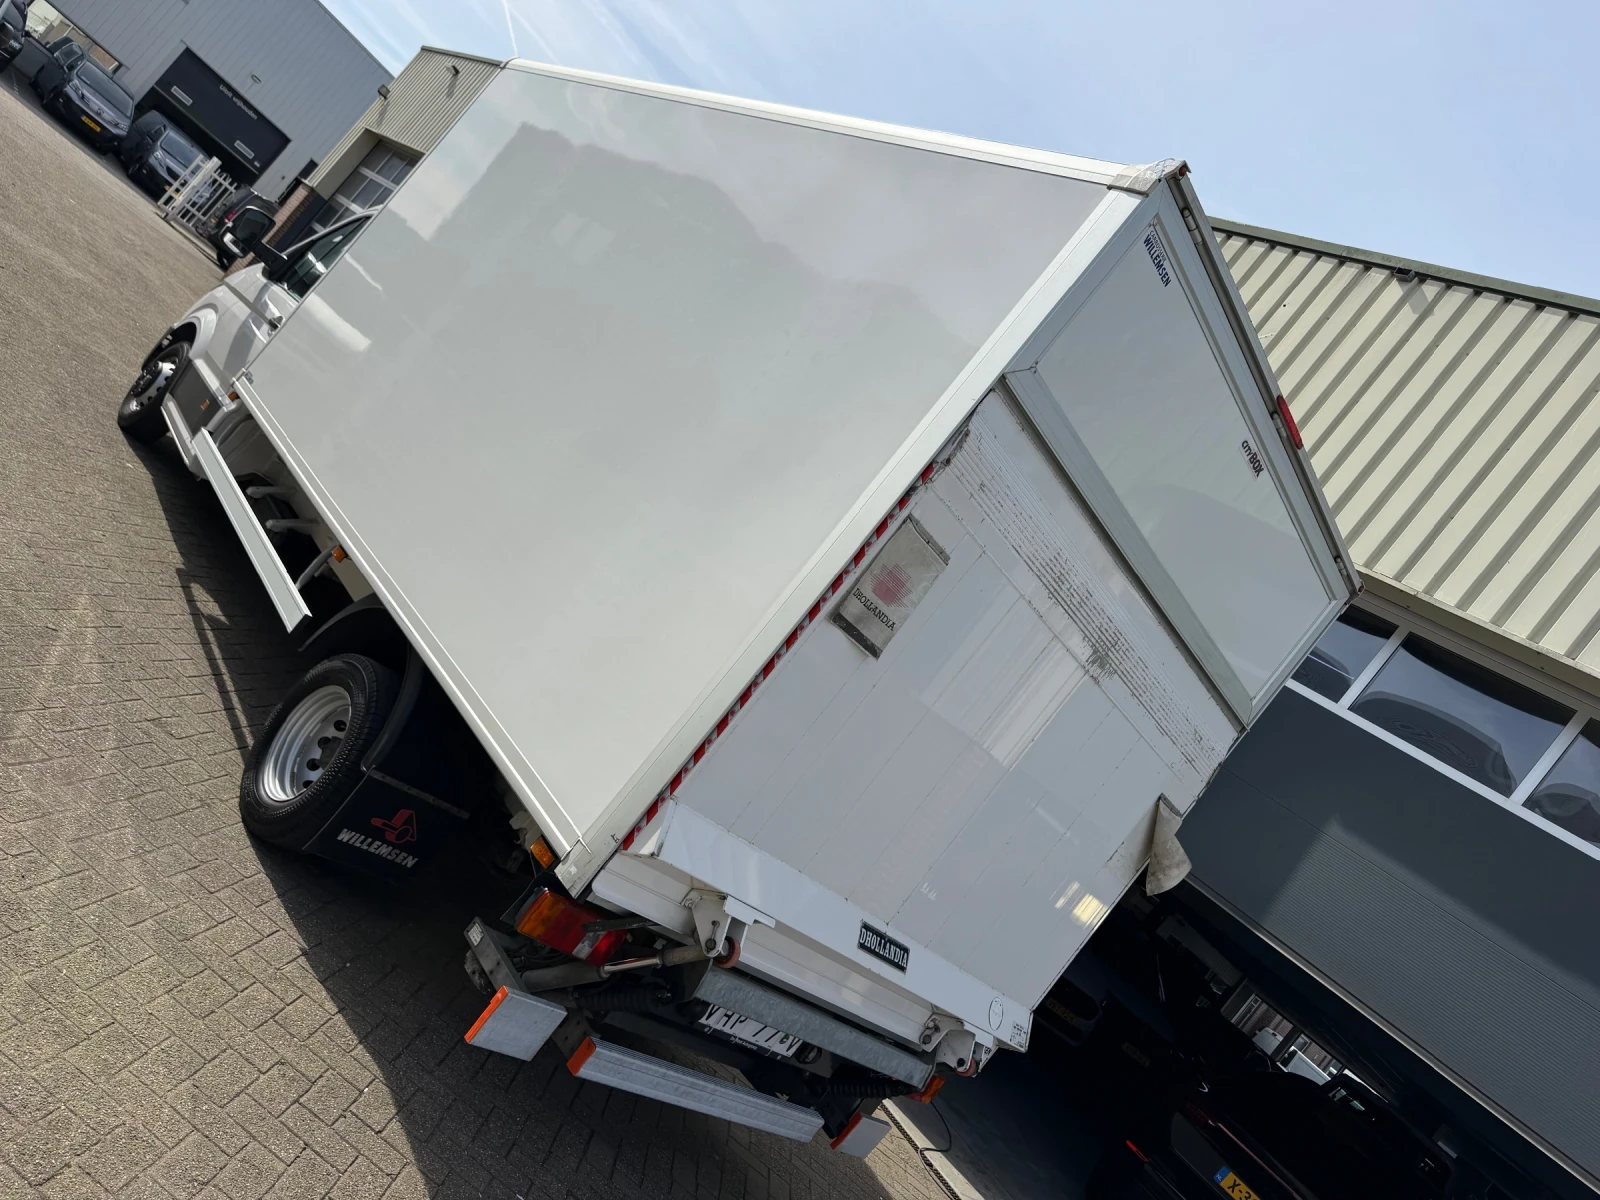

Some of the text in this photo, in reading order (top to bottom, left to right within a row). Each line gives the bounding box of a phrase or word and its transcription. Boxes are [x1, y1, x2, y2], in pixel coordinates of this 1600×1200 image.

[1143, 234, 1172, 287] WILLEMSEN
[853, 588, 896, 631] DHOLLANDIA
[336, 828, 419, 869] WILLEMSEN
[859, 927, 907, 968] DHOLLANDIA
